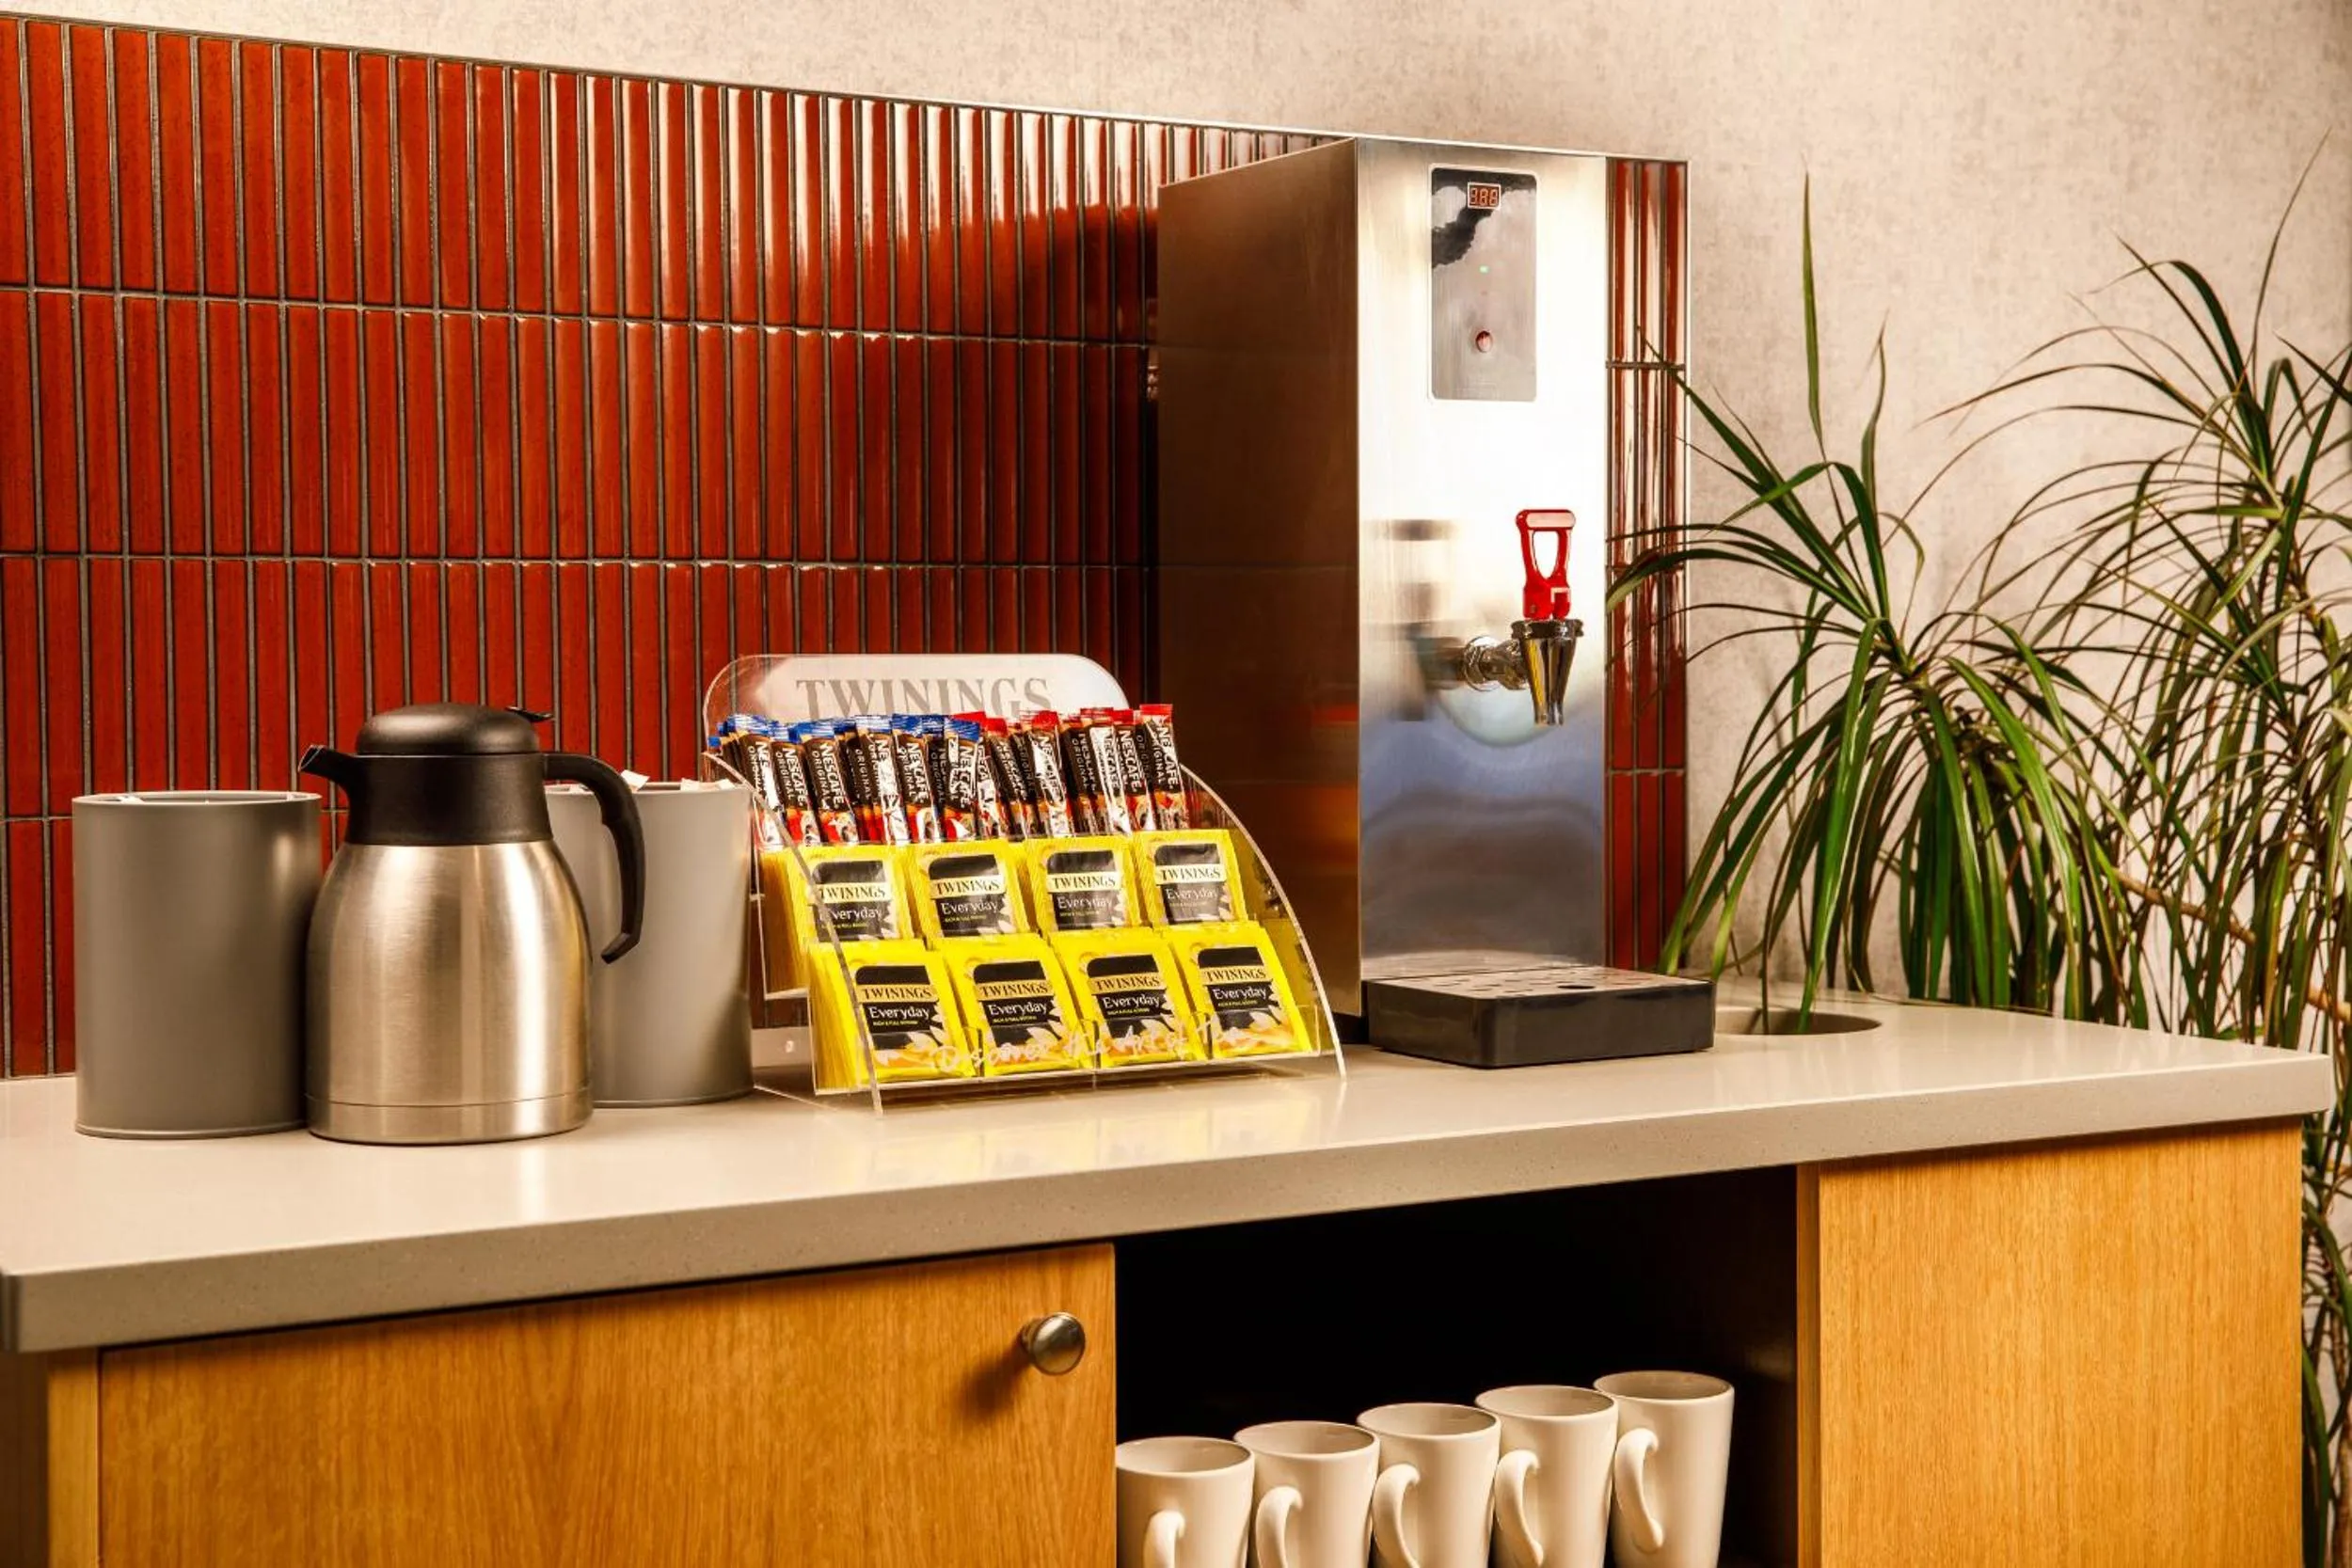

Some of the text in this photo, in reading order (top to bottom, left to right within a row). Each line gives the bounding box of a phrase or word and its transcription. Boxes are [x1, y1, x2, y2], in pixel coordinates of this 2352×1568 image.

[796, 676, 1053, 721] TWININGS
[775, 751, 795, 800] ORIGINAL
[811, 750, 831, 800] ORIGINAL
[1160, 866, 1221, 880] TWININGS
[936, 879, 1000, 895] TWININGS
[1052, 875, 1116, 889] TWININGS
[818, 886, 886, 899] TWININGS
[941, 899, 997, 914] Everyday
[1057, 895, 1112, 911] Everyday
[1205, 969, 1266, 982] TWININGS
[979, 982, 1048, 997] TWININGS
[1095, 976, 1160, 990] TWININGS
[862, 987, 931, 1000] TWININGS
[1213, 986, 1266, 1000] Everyday
[1103, 993, 1159, 1008] Everyday
[868, 1006, 930, 1020] Everyday
[988, 1001, 1047, 1015] Everyday
